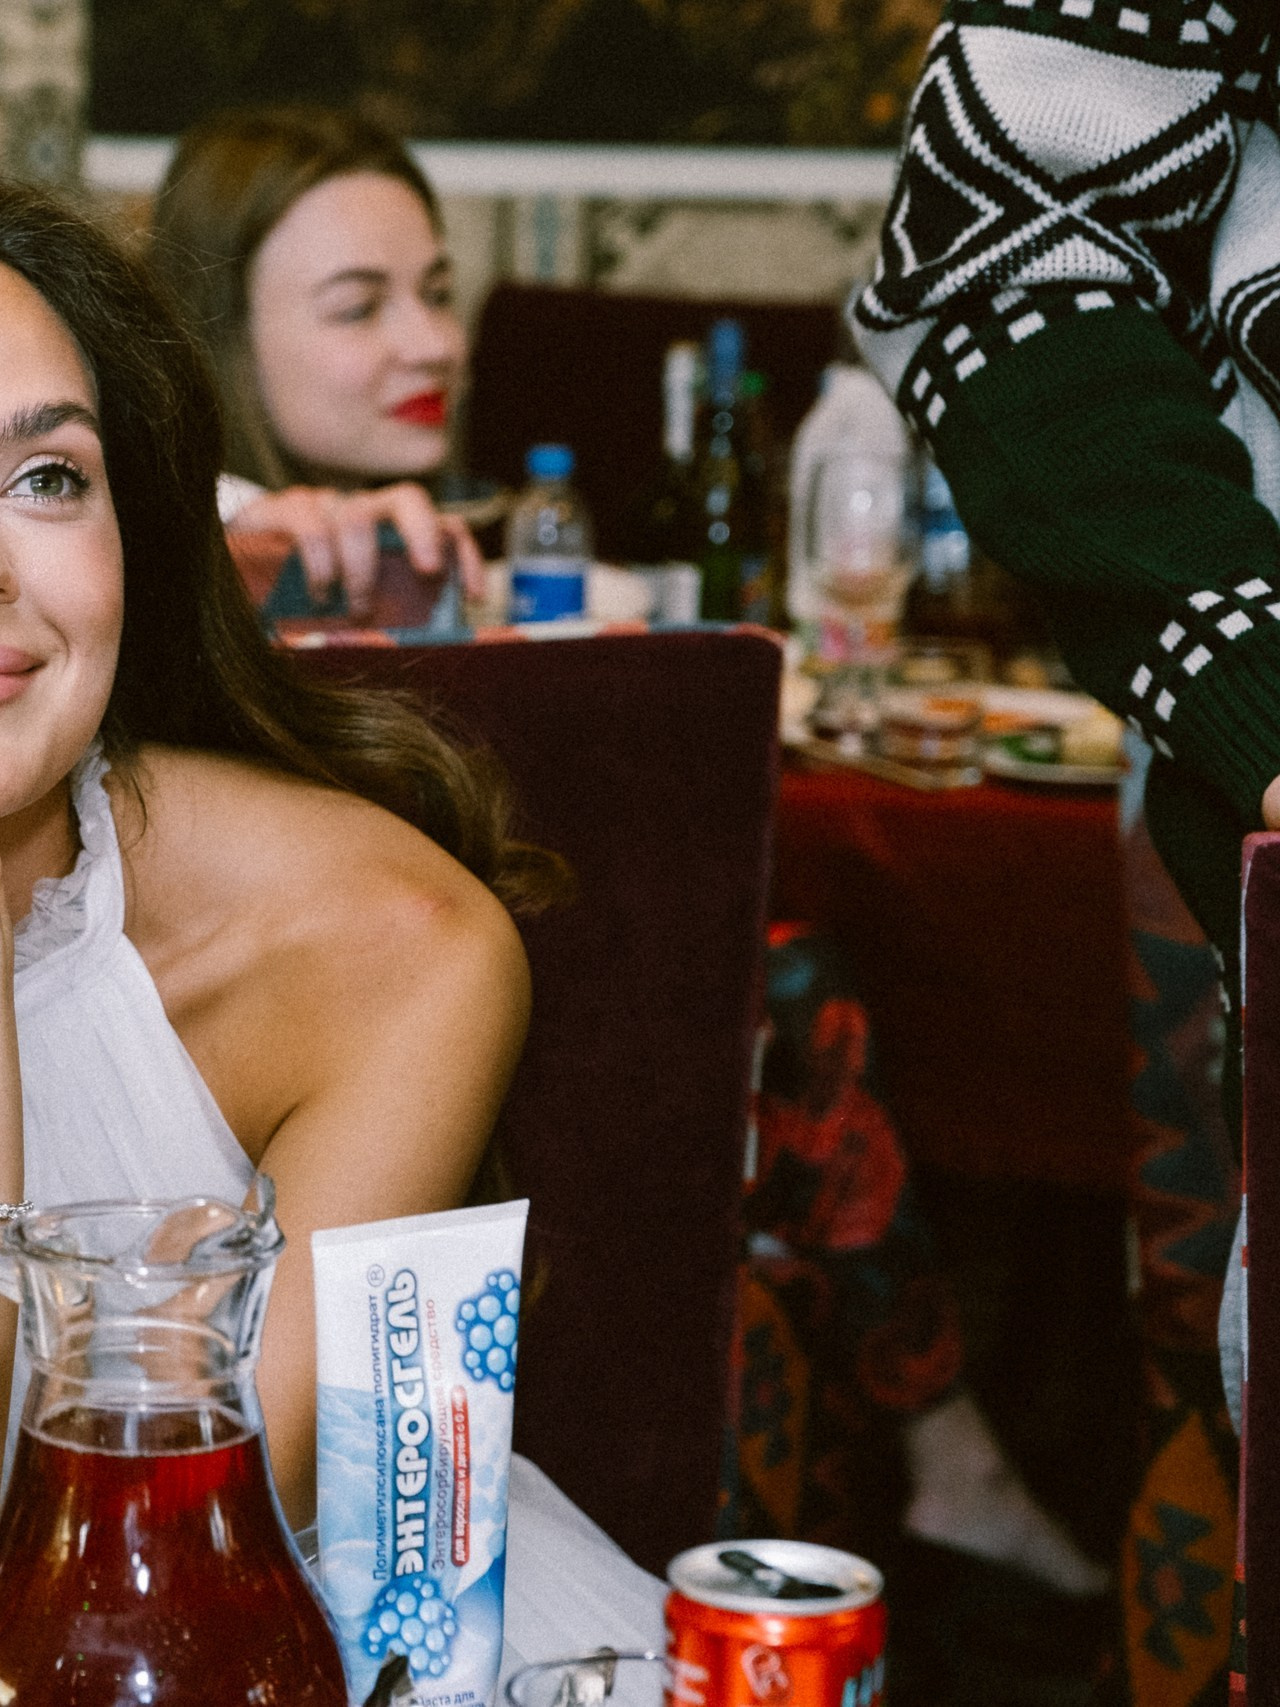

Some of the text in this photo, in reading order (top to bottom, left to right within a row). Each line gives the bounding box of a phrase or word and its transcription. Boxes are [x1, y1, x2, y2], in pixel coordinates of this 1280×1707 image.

[369, 1295, 384, 1394] полигидрат
[387, 1269, 430, 1577] ЭНТЕРОСГЕЛЬ
[426, 1299, 451, 1571] Энтеросорбирующее средство
[373, 1397, 387, 1580] Полиметилсилоксана
[454, 1691, 475, 1705] для
